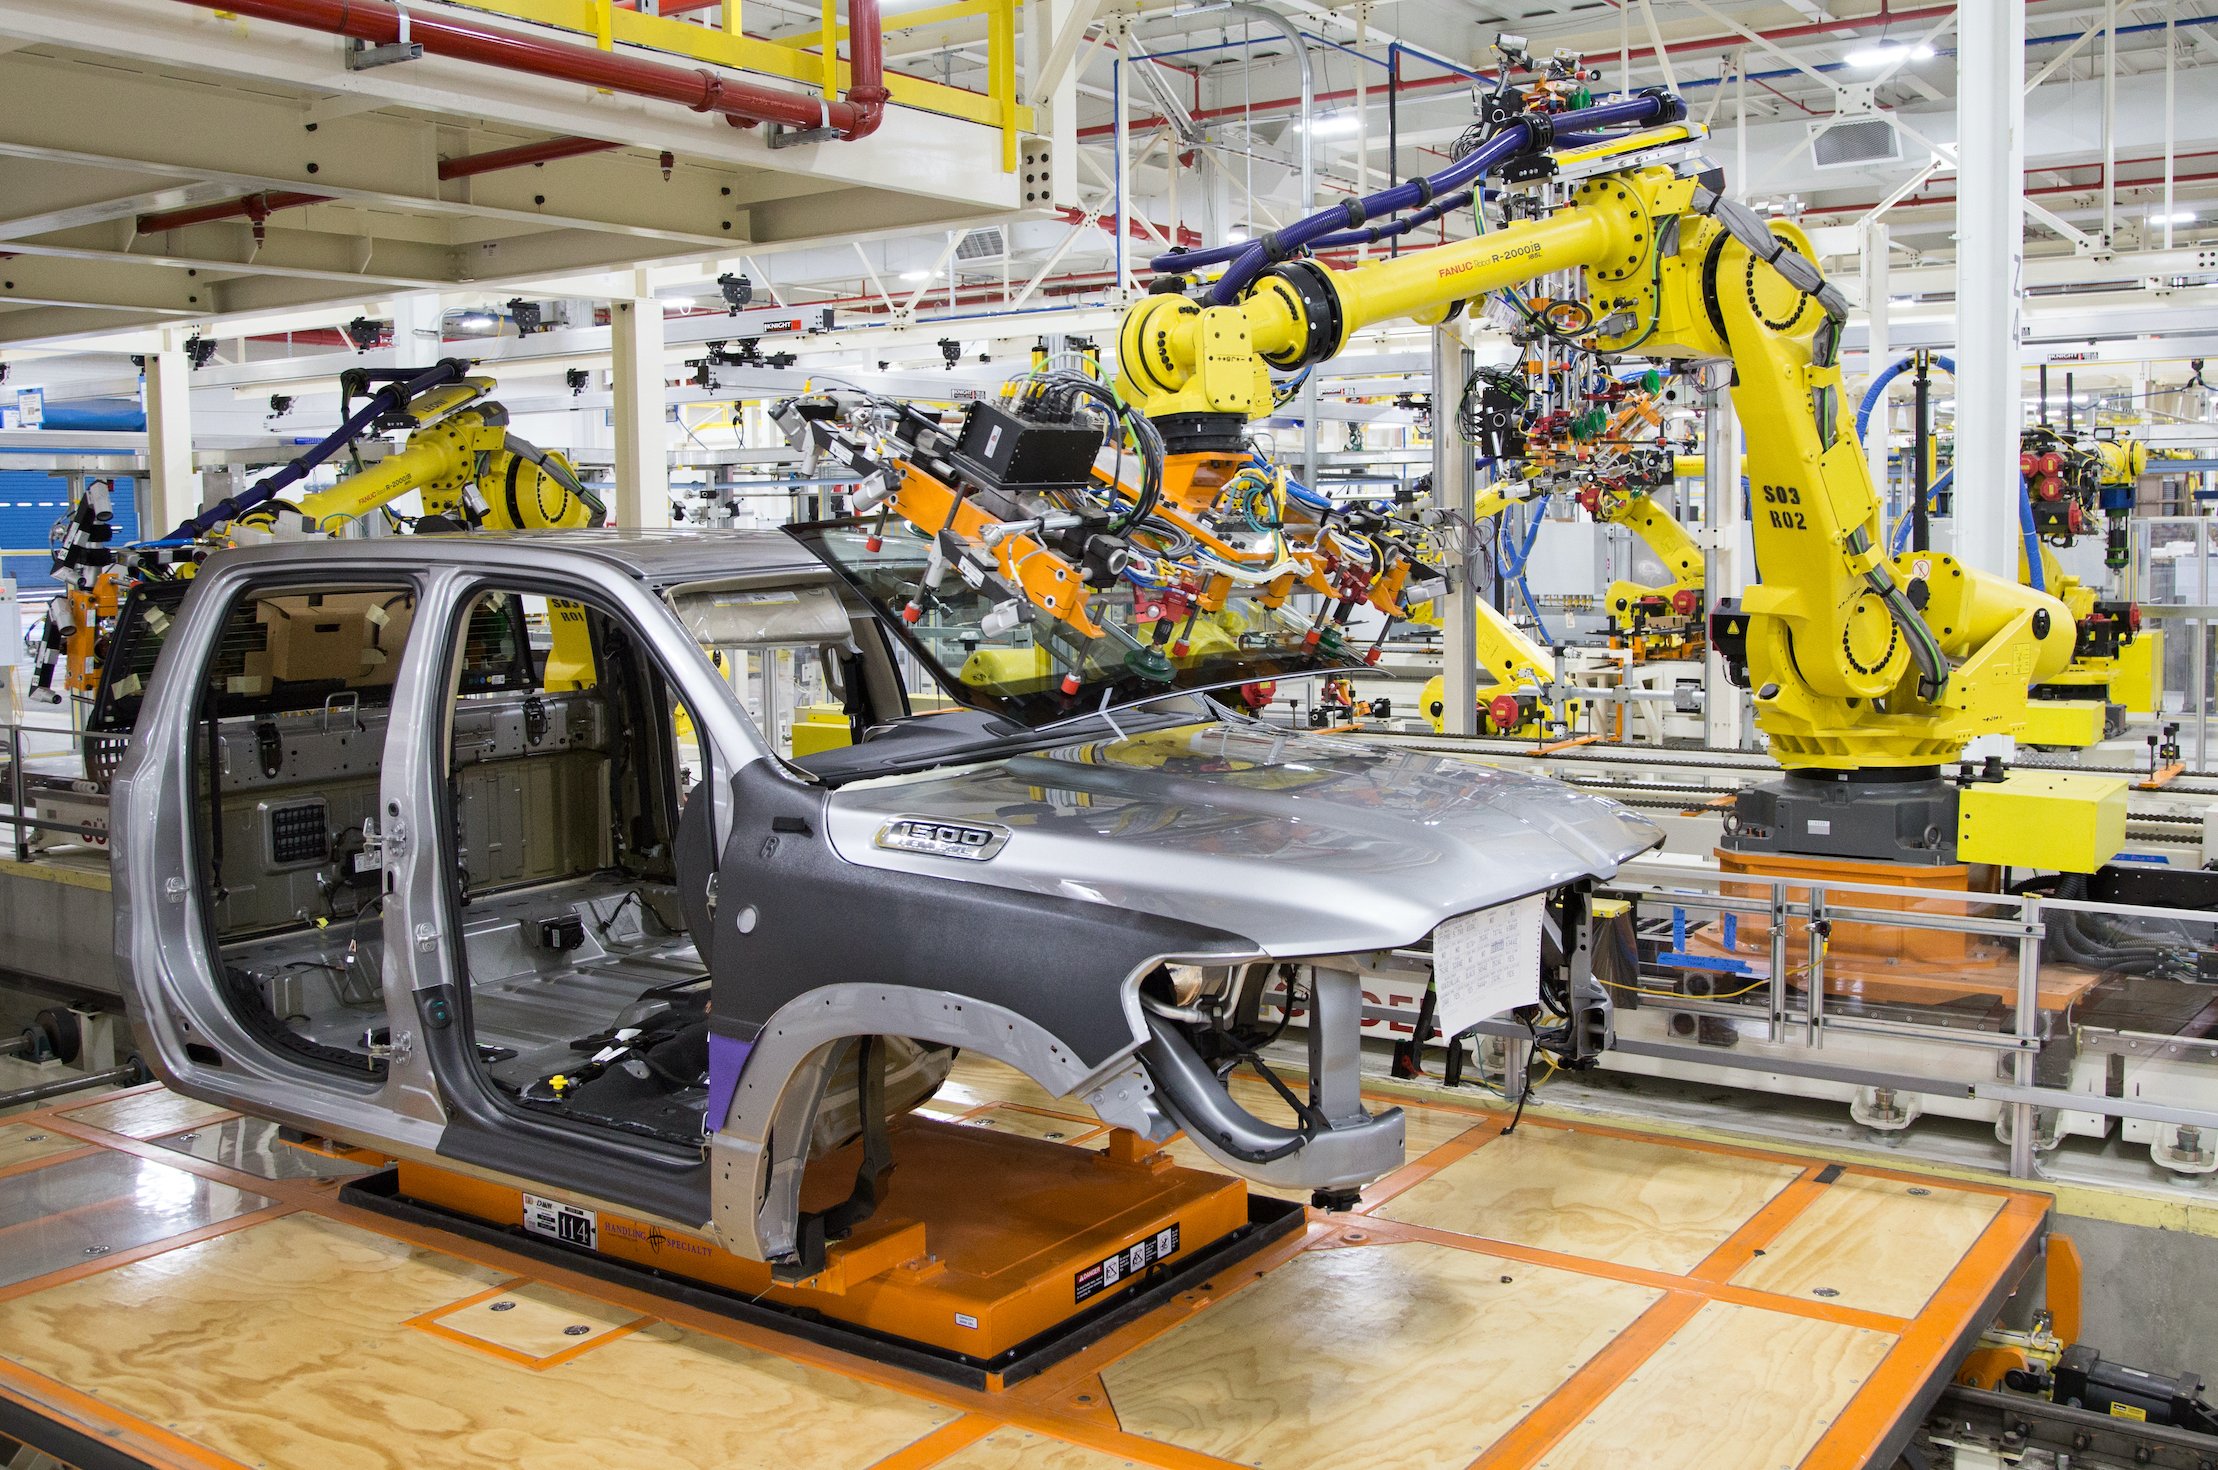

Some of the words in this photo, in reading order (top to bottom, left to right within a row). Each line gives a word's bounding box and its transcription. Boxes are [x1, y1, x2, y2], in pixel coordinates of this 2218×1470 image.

[1438, 261, 1474, 278] FANUC
[1491, 241, 1541, 263] R-2000iB
[767, 321, 792, 330] KNIGHT
[358, 491, 377, 505] FANUC
[1763, 485, 1800, 504] S03
[1769, 510, 1807, 530] R02
[900, 821, 988, 846] 1500
[561, 1215, 588, 1243] 114
[604, 1222, 647, 1241] HANDLING
[666, 1239, 712, 1256] SPECIALTY
[1083, 1265, 1102, 1280] DANGER
